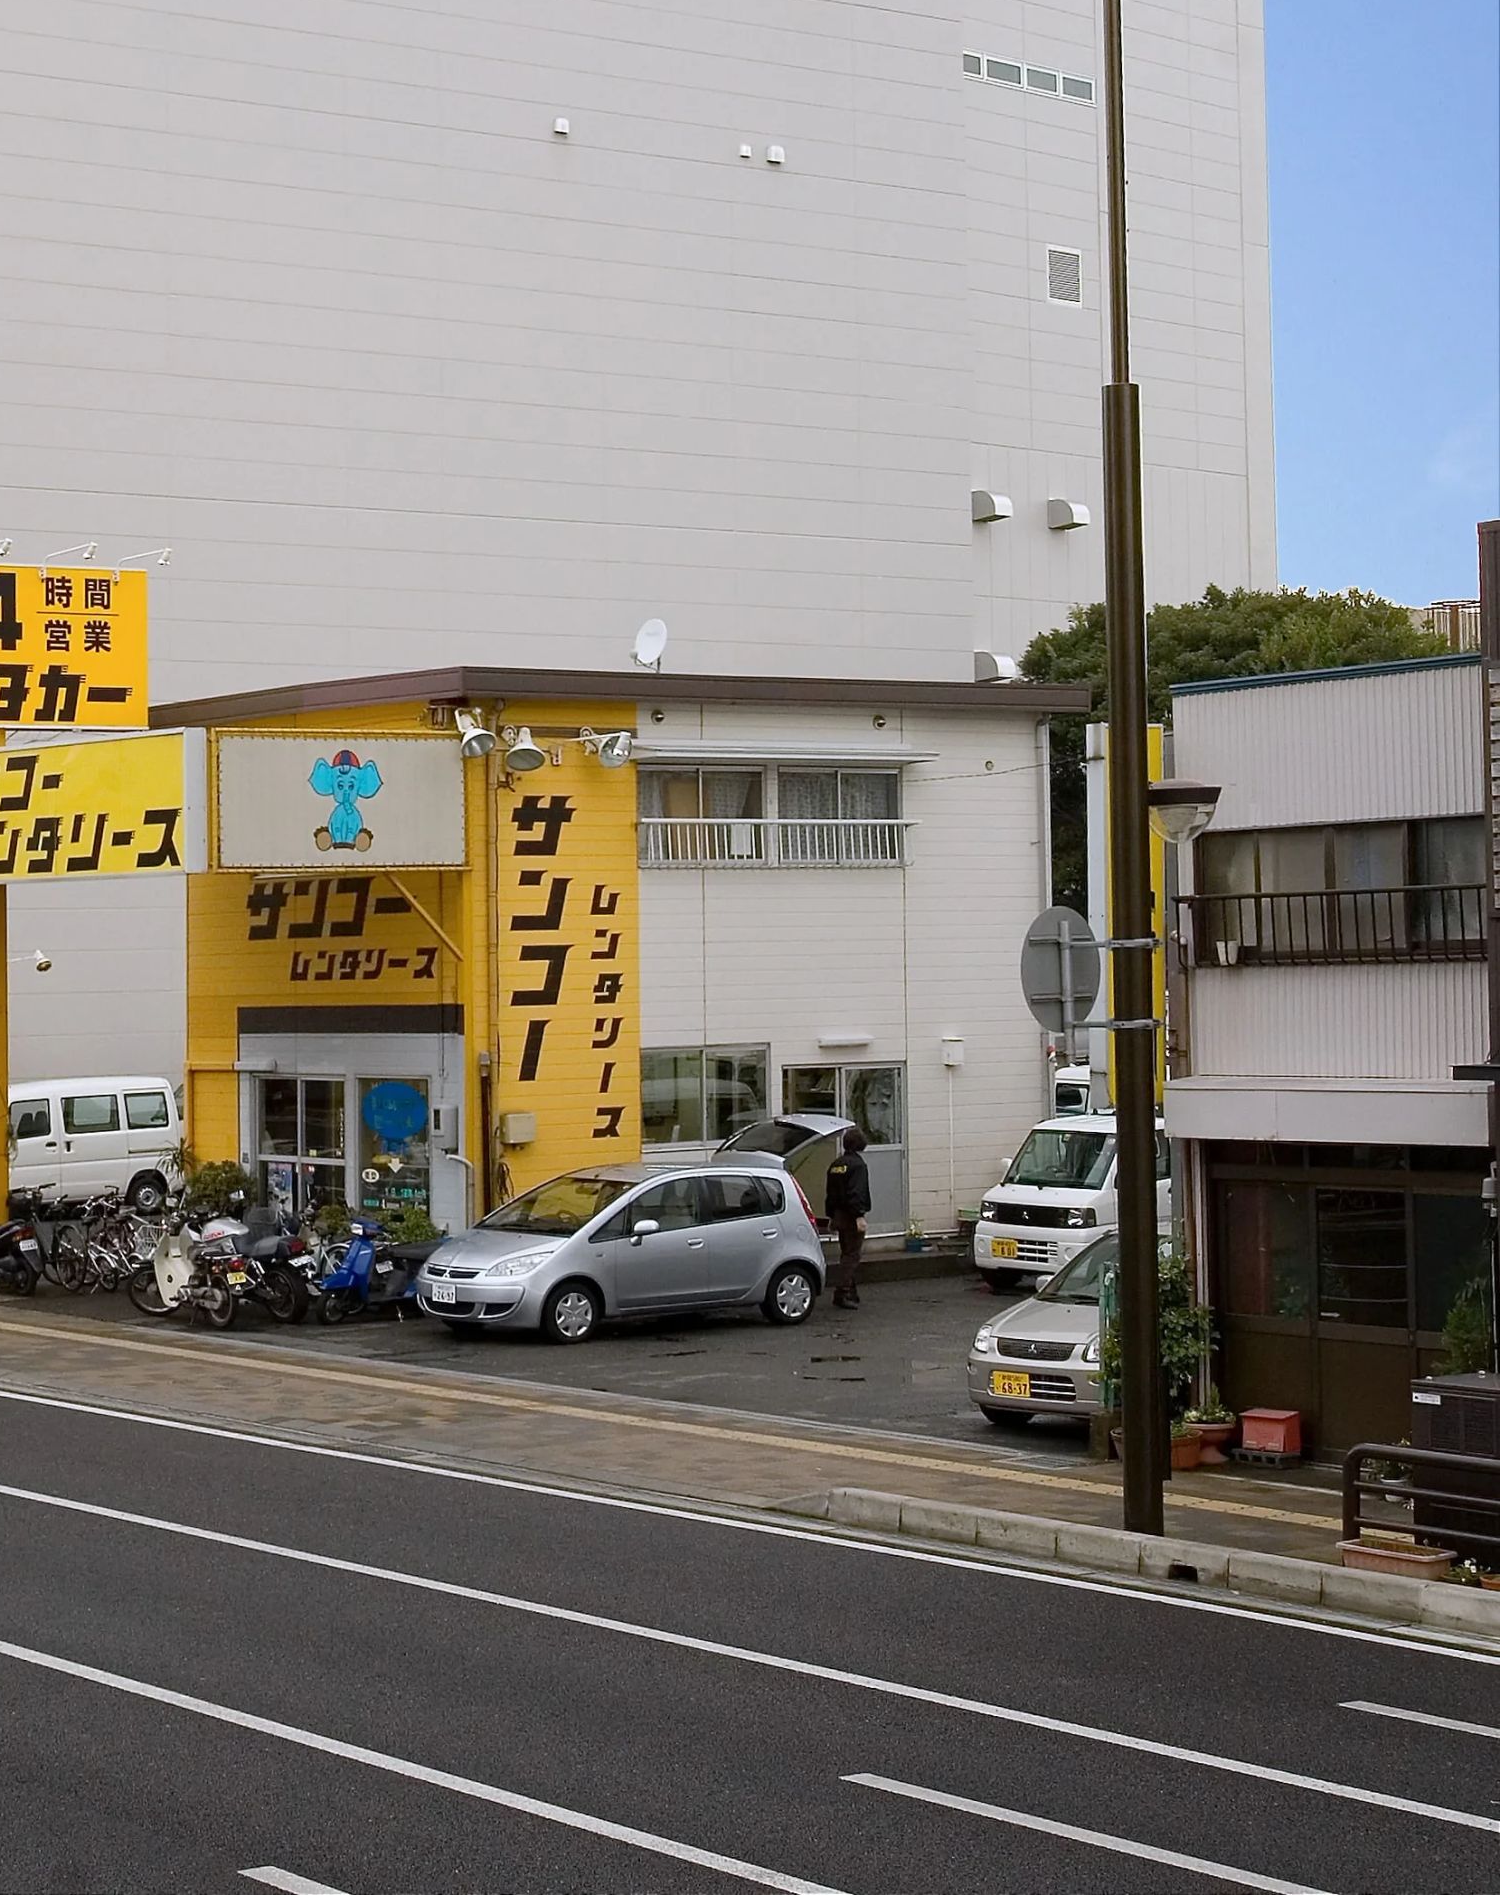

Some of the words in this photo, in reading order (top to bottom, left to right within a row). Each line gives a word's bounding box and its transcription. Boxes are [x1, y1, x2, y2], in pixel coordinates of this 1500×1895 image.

[247, 876, 417, 940] サンコー
[290, 947, 438, 981] レンタリース
[510, 795, 577, 1082] サンコー
[590, 884, 626, 1139] レンタリース
